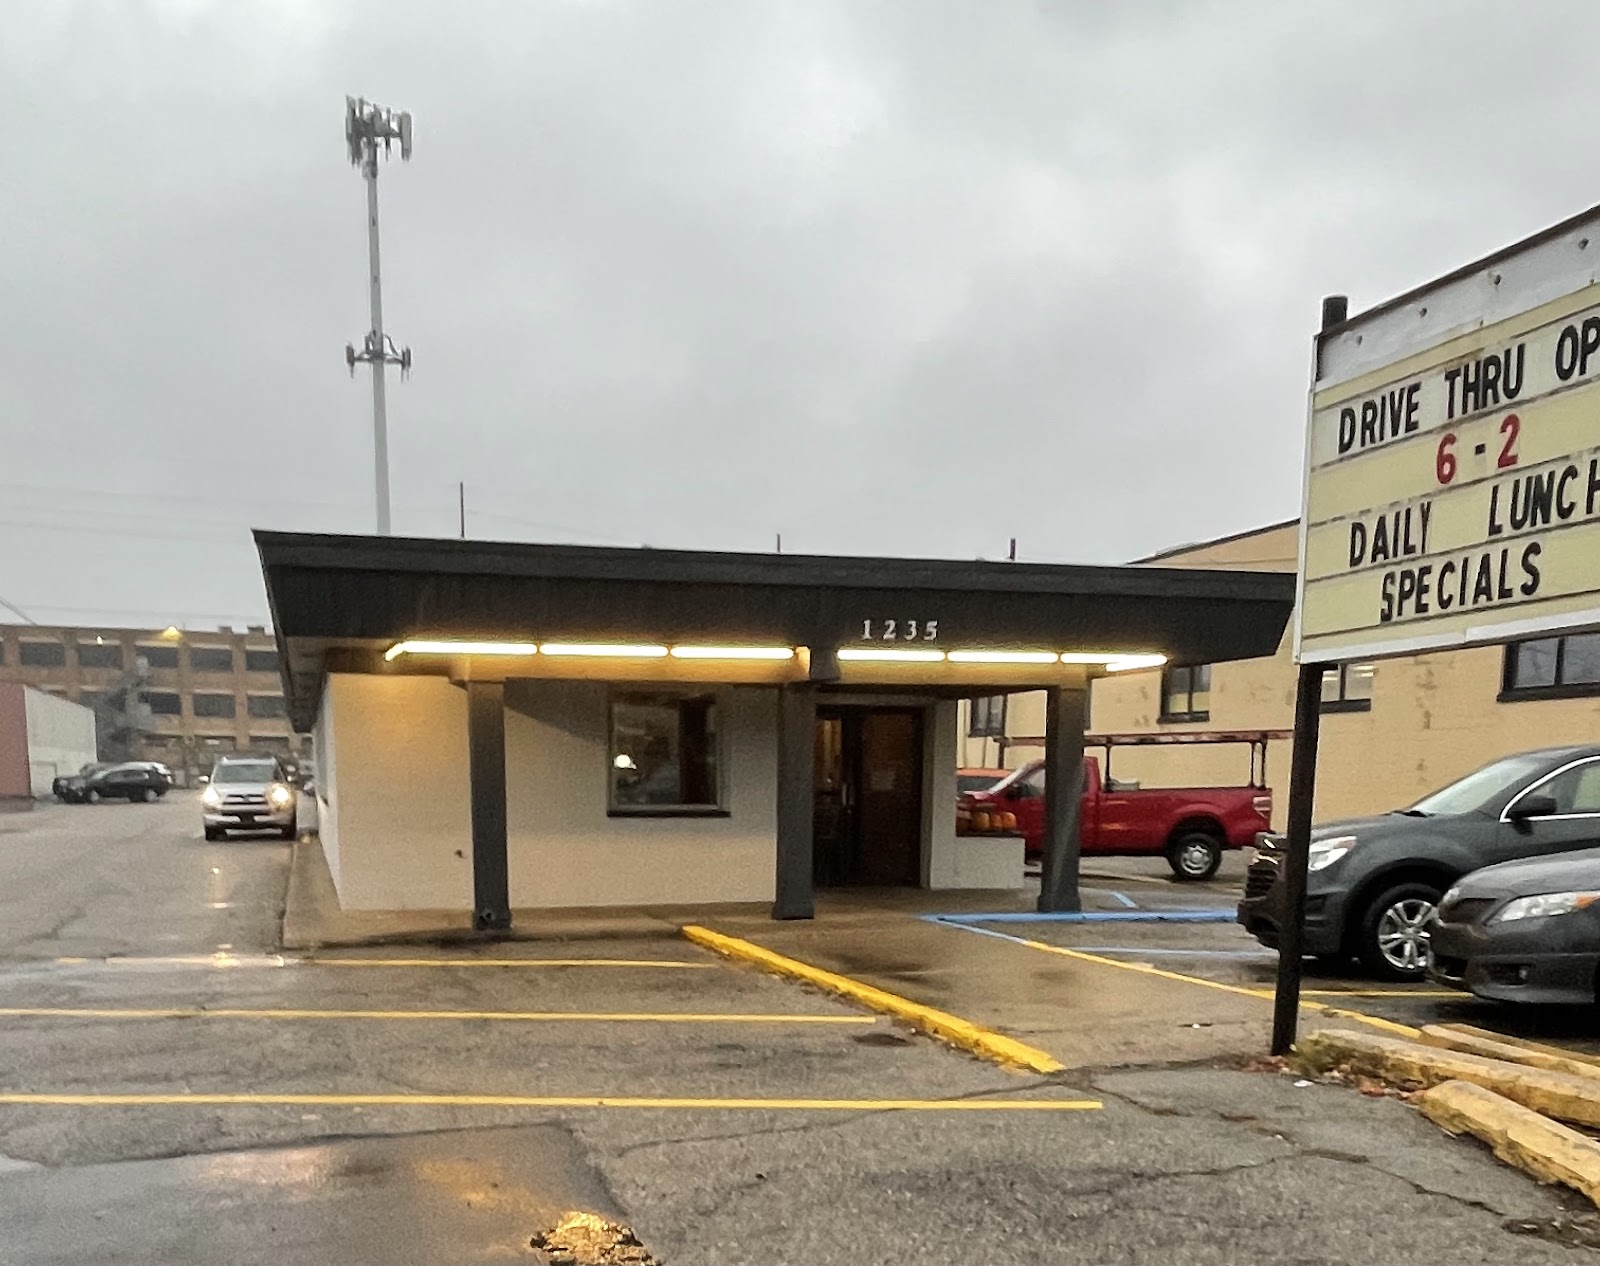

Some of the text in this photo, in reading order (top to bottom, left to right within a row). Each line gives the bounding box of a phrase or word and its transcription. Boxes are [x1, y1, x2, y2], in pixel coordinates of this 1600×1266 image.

[1338, 381, 1421, 455] DRIVE
[1445, 343, 1526, 419] THRU
[1349, 501, 1432, 568] DAILY
[1380, 541, 1542, 622] SPECIALS
[861, 619, 938, 640] 1235
